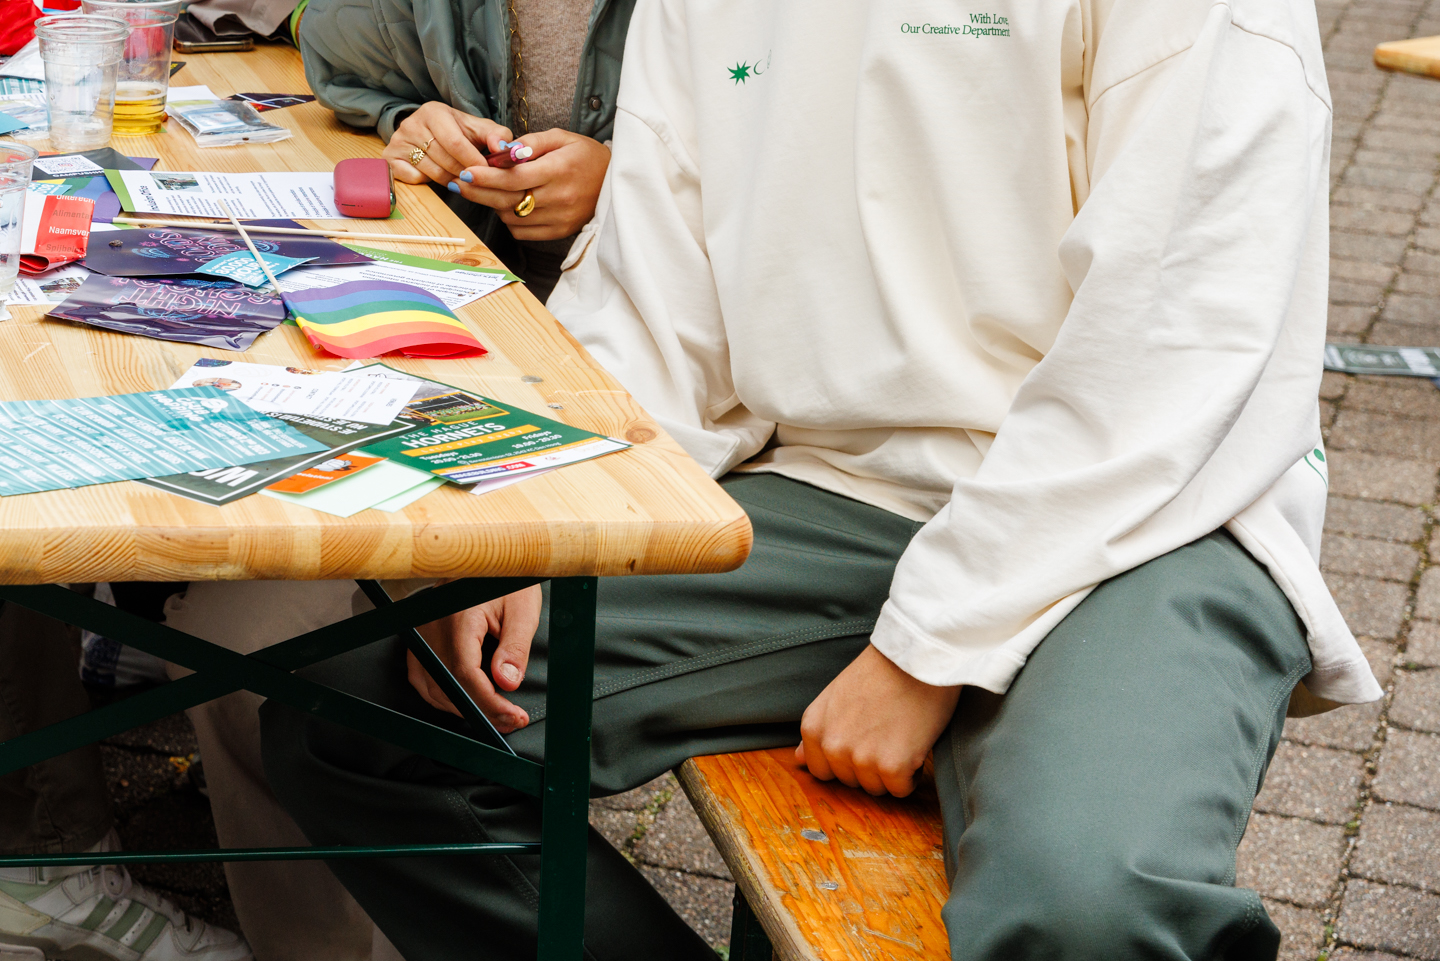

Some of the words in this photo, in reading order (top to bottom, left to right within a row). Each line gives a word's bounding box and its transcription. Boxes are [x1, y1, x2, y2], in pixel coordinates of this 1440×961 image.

[969, 13, 991, 24] With
[901, 23, 921, 34] Our
[922, 23, 960, 35] Creative
[118, 288, 242, 317] NIGHT
[433, 421, 479, 434] HAGUE
[401, 423, 506, 449] HORNETS
